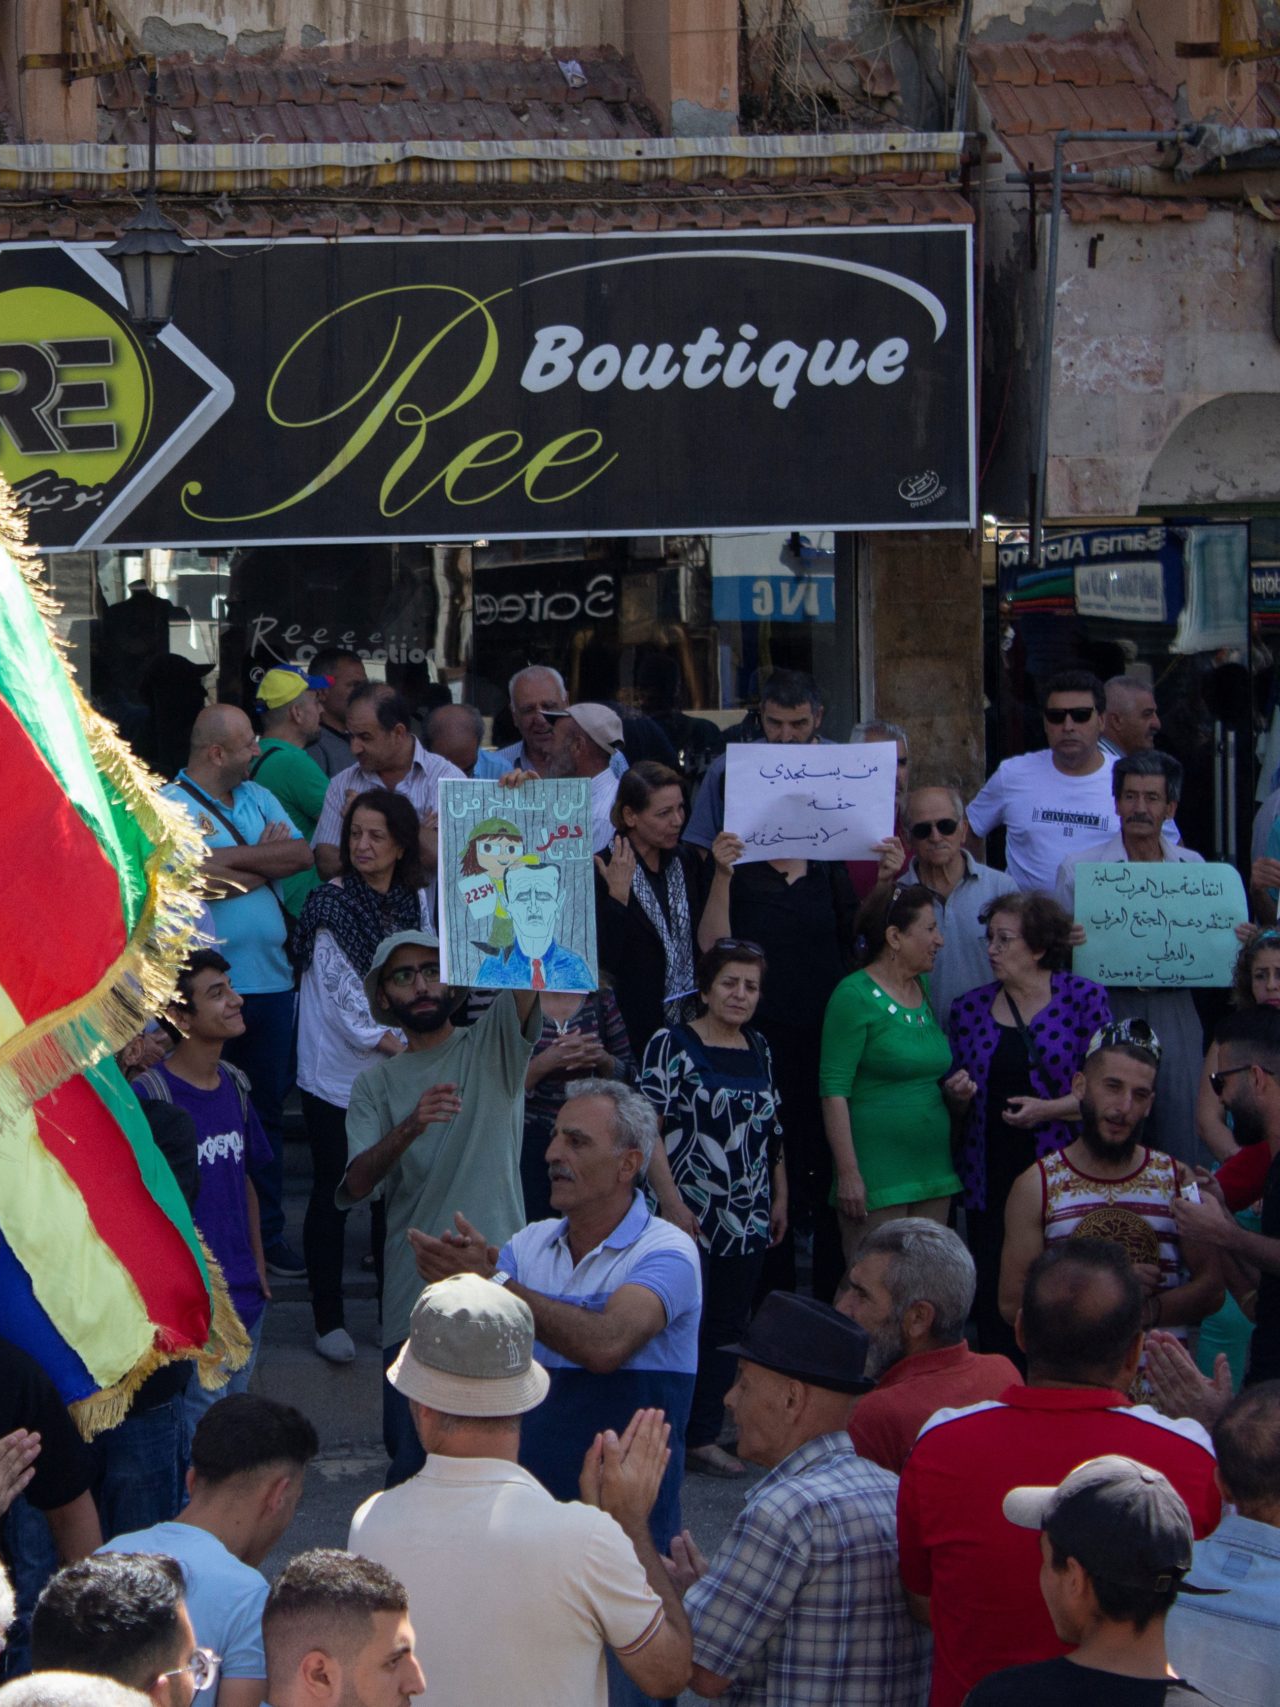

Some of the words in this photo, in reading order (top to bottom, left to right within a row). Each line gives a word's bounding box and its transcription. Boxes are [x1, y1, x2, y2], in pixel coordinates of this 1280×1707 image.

[521, 323, 910, 409] Boutique
[184, 285, 619, 521] Ree
[1044, 812, 1098, 825] GIVENCHY
[464, 883, 496, 905] 2254
